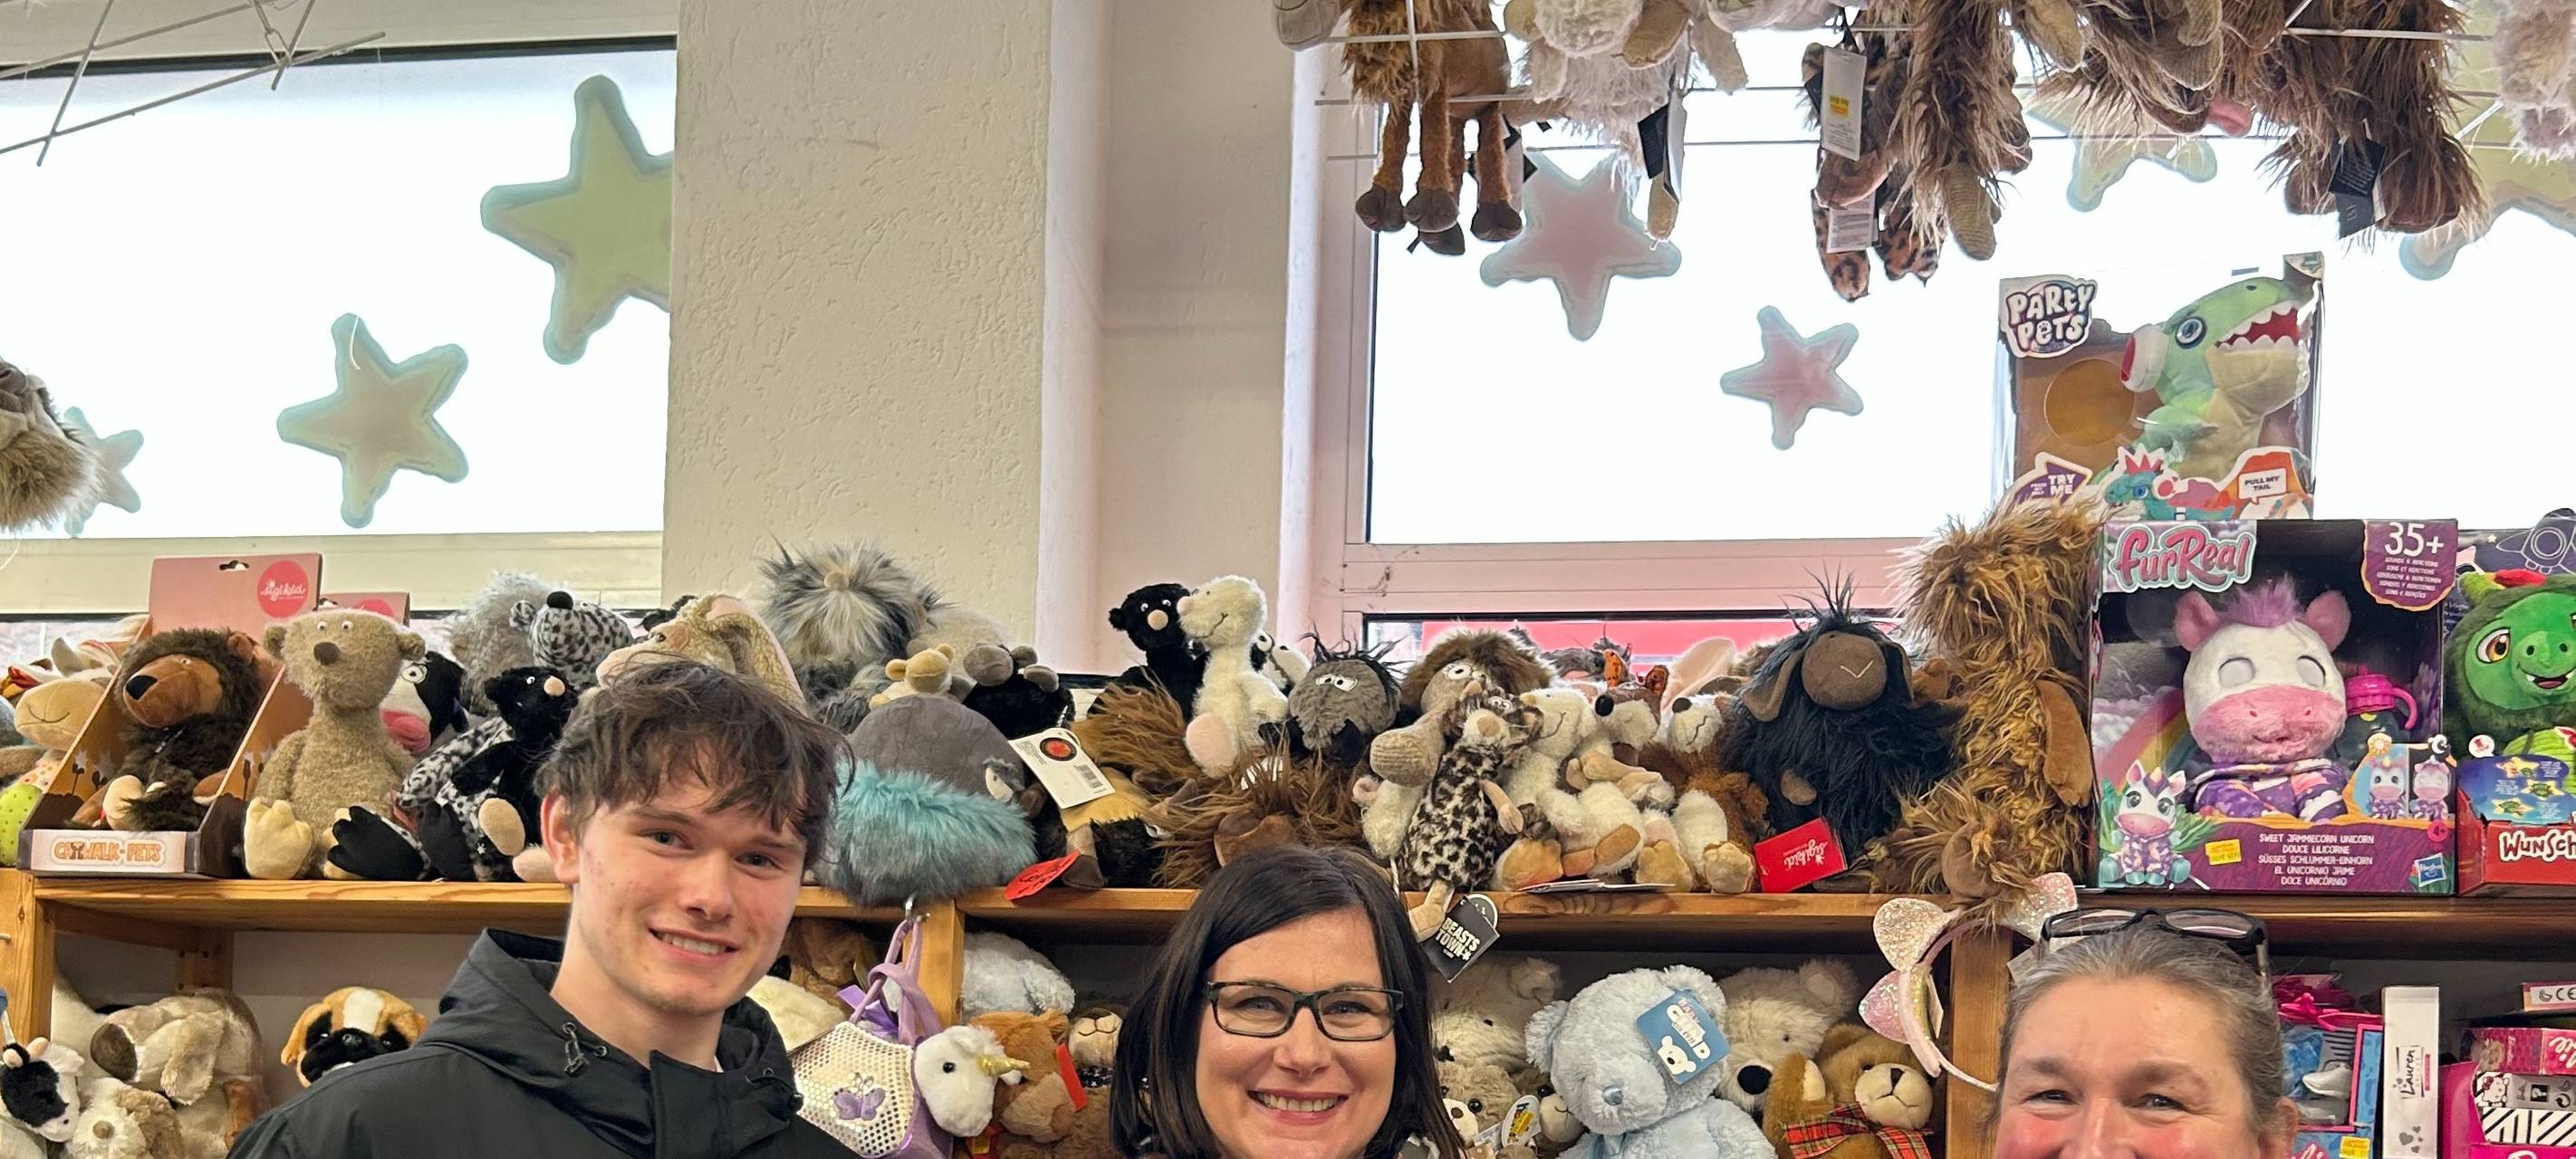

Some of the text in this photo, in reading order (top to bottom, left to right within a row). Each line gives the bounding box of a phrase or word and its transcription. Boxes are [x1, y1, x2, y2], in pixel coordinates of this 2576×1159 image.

[2048, 474, 2076, 485] TRY
[2050, 484, 2073, 495] ME
[2385, 522, 2444, 557] 35+
[2433, 826, 2446, 836] 4+
[2259, 834, 2375, 844] SWEET JAMMIECORN UNICORN
[2283, 845, 2350, 854] DOUCE LILICORNE
[2290, 856, 2373, 865] SCHLUMMER-EINHORN
[2274, 866, 2355, 876] EL UNICORNIO JAIME
[2281, 876, 2302, 885] DOCE
[1442, 916, 1481, 952] BEASTS
[1435, 928, 1466, 957] TOWN
[2400, 1049, 2416, 1095] Lauren
